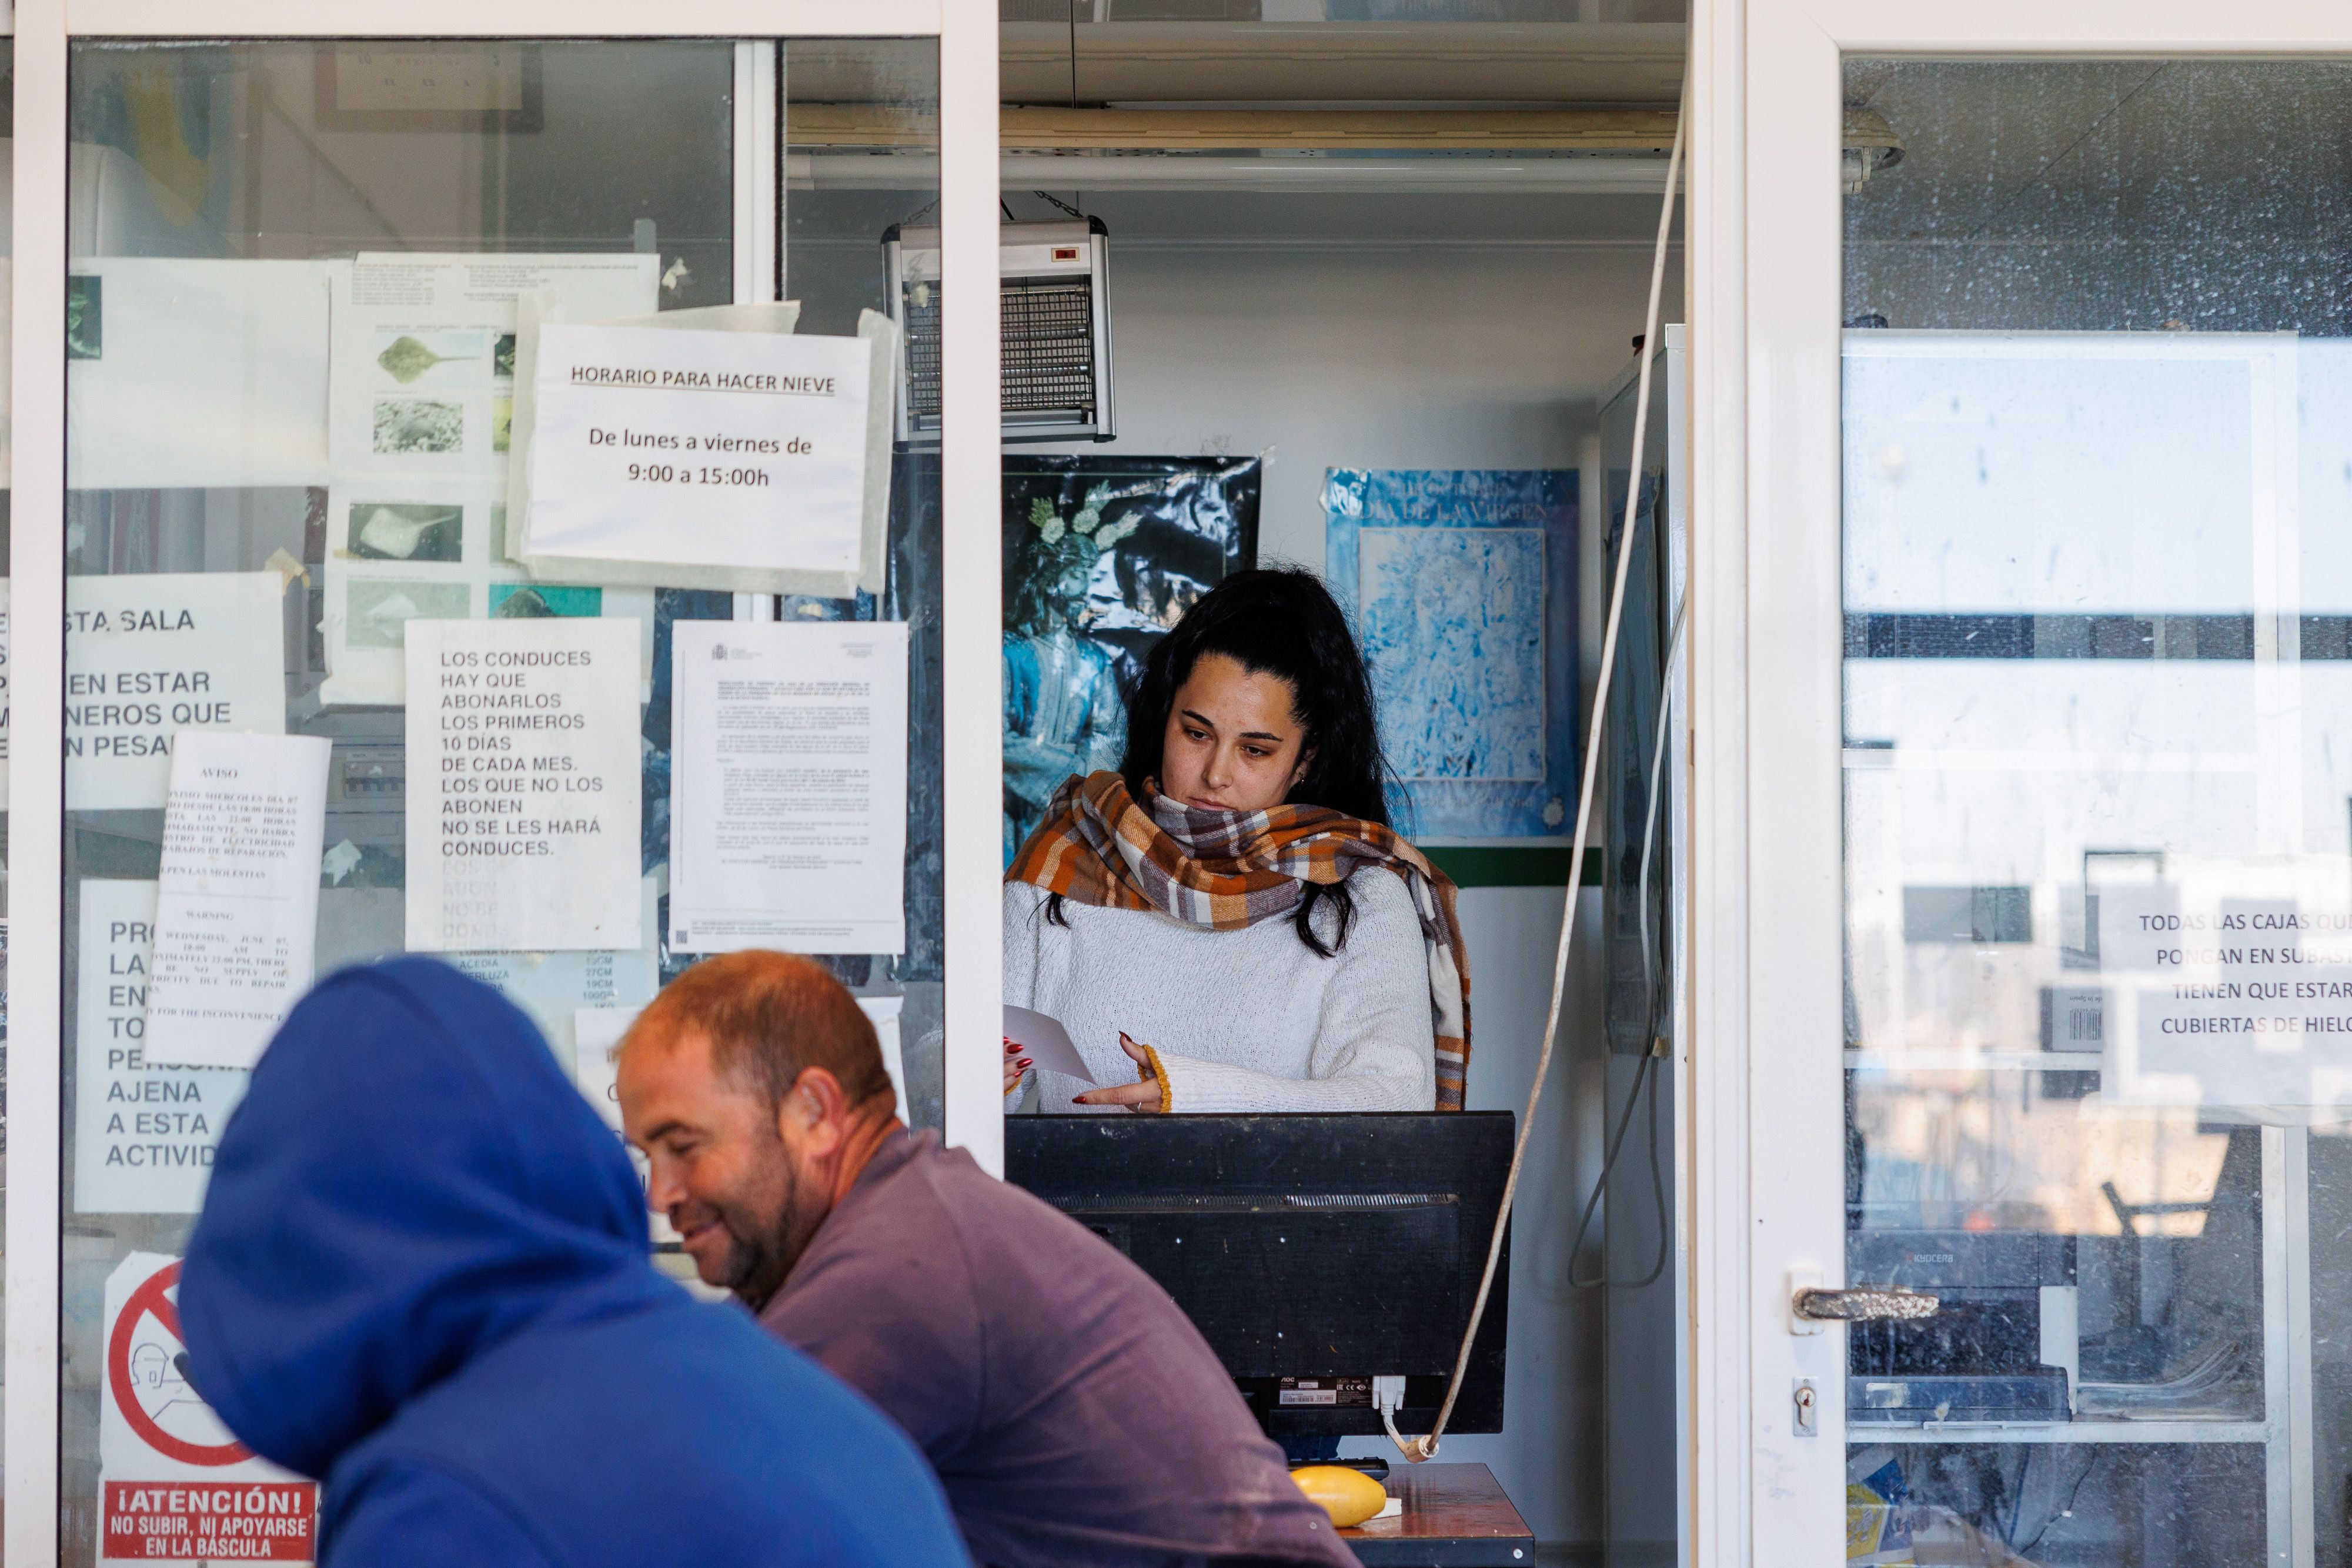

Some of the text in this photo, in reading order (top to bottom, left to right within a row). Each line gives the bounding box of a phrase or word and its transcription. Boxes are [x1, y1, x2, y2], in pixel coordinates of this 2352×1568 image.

[571, 366, 835, 393] HORARIO PARA HACER NIEVE
[589, 428, 812, 456] De lunes a viernes de
[628, 463, 769, 486] 9:00 a 15:00h
[121, 610, 195, 631] SALA
[441, 651, 591, 667] LOS CONDUCES
[70, 672, 211, 695] EN ESTAR
[441, 673, 526, 688] HAY QUE
[441, 694, 562, 709] ABONARLOS
[65, 703, 231, 726] NEROS QUE
[441, 714, 585, 730] LOS PRIMEROS
[94, 735, 175, 757] PESA
[442, 733, 511, 751] 10 DÍAS
[201, 767, 238, 779] AVISO
[442, 757, 578, 772] DE CADA MES.
[442, 777, 603, 793] LOS QUE NO LOS
[442, 800, 522, 814] ABONEN
[442, 815, 601, 835] NO SE LES HARÁ
[442, 841, 554, 857] CONDUCES.
[2139, 914, 2206, 931] TODAS
[2213, 914, 2246, 930] LAS
[2253, 913, 2310, 930] CAJAS
[110, 954, 145, 975] LA
[2157, 948, 2243, 965] PONGAN
[2251, 948, 2274, 964] EN
[2173, 982, 2352, 1001] TIENEN QUE ESTAR
[2161, 1017, 2267, 1034] CUBIERTAS
[2274, 1017, 2299, 1032] DE
[107, 1081, 202, 1103] AJENA
[106, 1113, 209, 1135] A ESTA
[1914, 1253, 1953, 1263] KYOCERA
[119, 1486, 301, 1514] ¡ATENCIÓN!
[111, 1516, 308, 1537] NO SUBIR, NI APOYARSE
[146, 1534, 272, 1557] EN LA BÁSCULA
